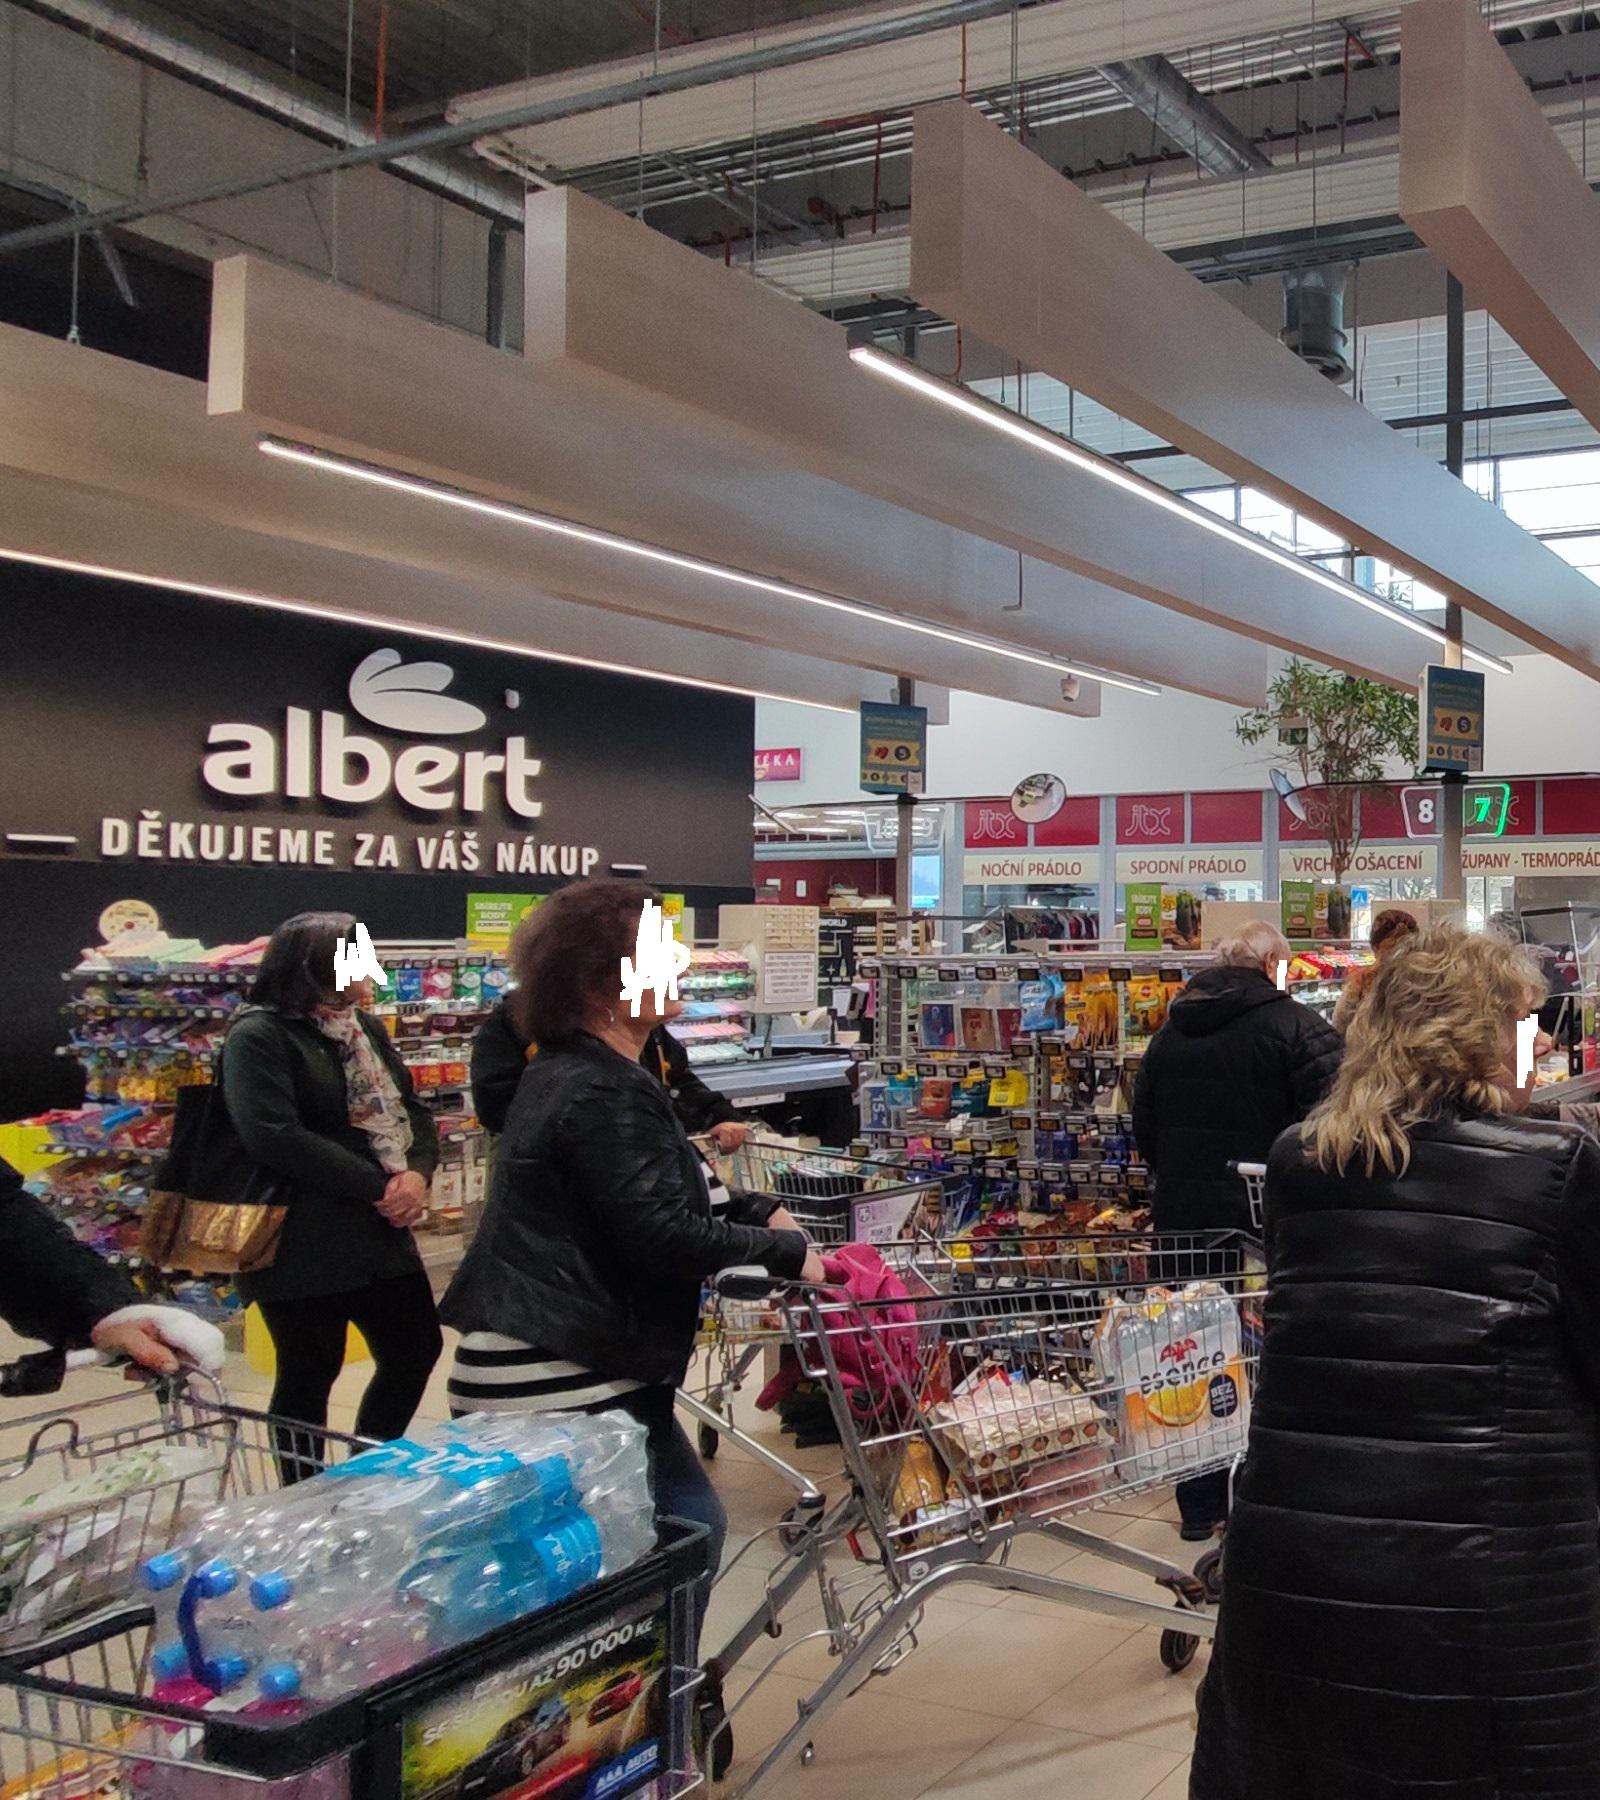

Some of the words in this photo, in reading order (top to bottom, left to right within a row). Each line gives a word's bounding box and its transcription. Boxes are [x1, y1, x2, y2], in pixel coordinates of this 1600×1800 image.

[202, 706, 542, 818] albert
[1418, 799, 1434, 824] 8
[1475, 797, 1491, 823] 7
[101, 810, 335, 865] DĚKUJEME
[354, 831, 399, 868] ZA
[417, 829, 480, 871] VÁŠ
[497, 831, 600, 877] NÁKUP
[981, 859, 1024, 877] NOČNÍ
[1028, 858, 1082, 876] PRÁDLO
[1130, 856, 1187, 875] SPODNÍ
[1189, 855, 1247, 873] PRÁDLO
[1293, 853, 1351, 871] VRCH
[1355, 851, 1423, 871] OŠACENÍ
[1462, 850, 1510, 869] ŽUPANY
[1140, 1350, 1226, 1395] esence
[555, 1649, 587, 1678] 90
[590, 1624, 634, 1660] 000
